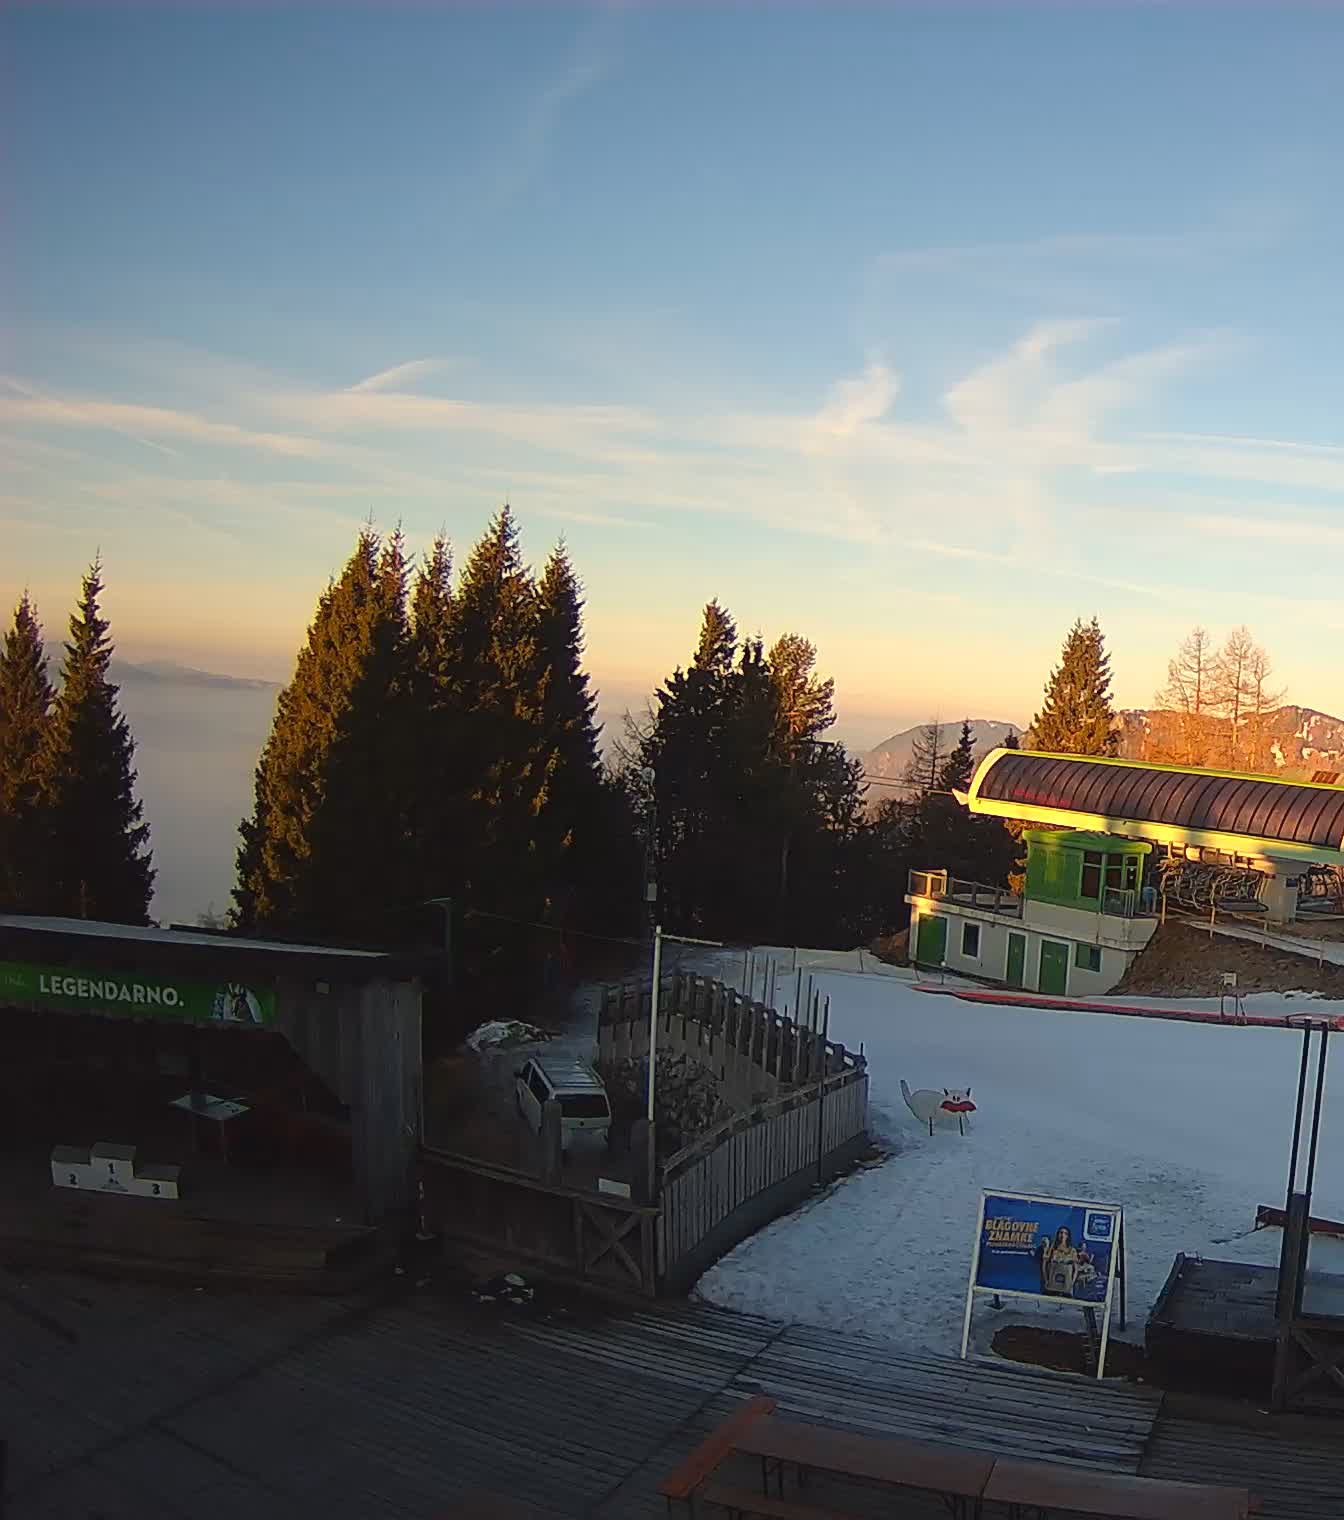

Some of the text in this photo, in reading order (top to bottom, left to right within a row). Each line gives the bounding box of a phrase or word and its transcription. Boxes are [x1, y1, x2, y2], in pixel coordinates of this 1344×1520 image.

[39, 974, 185, 1007] LEGENDARNO.
[69, 1173, 78, 1186] 2
[151, 1183, 161, 1195] 3
